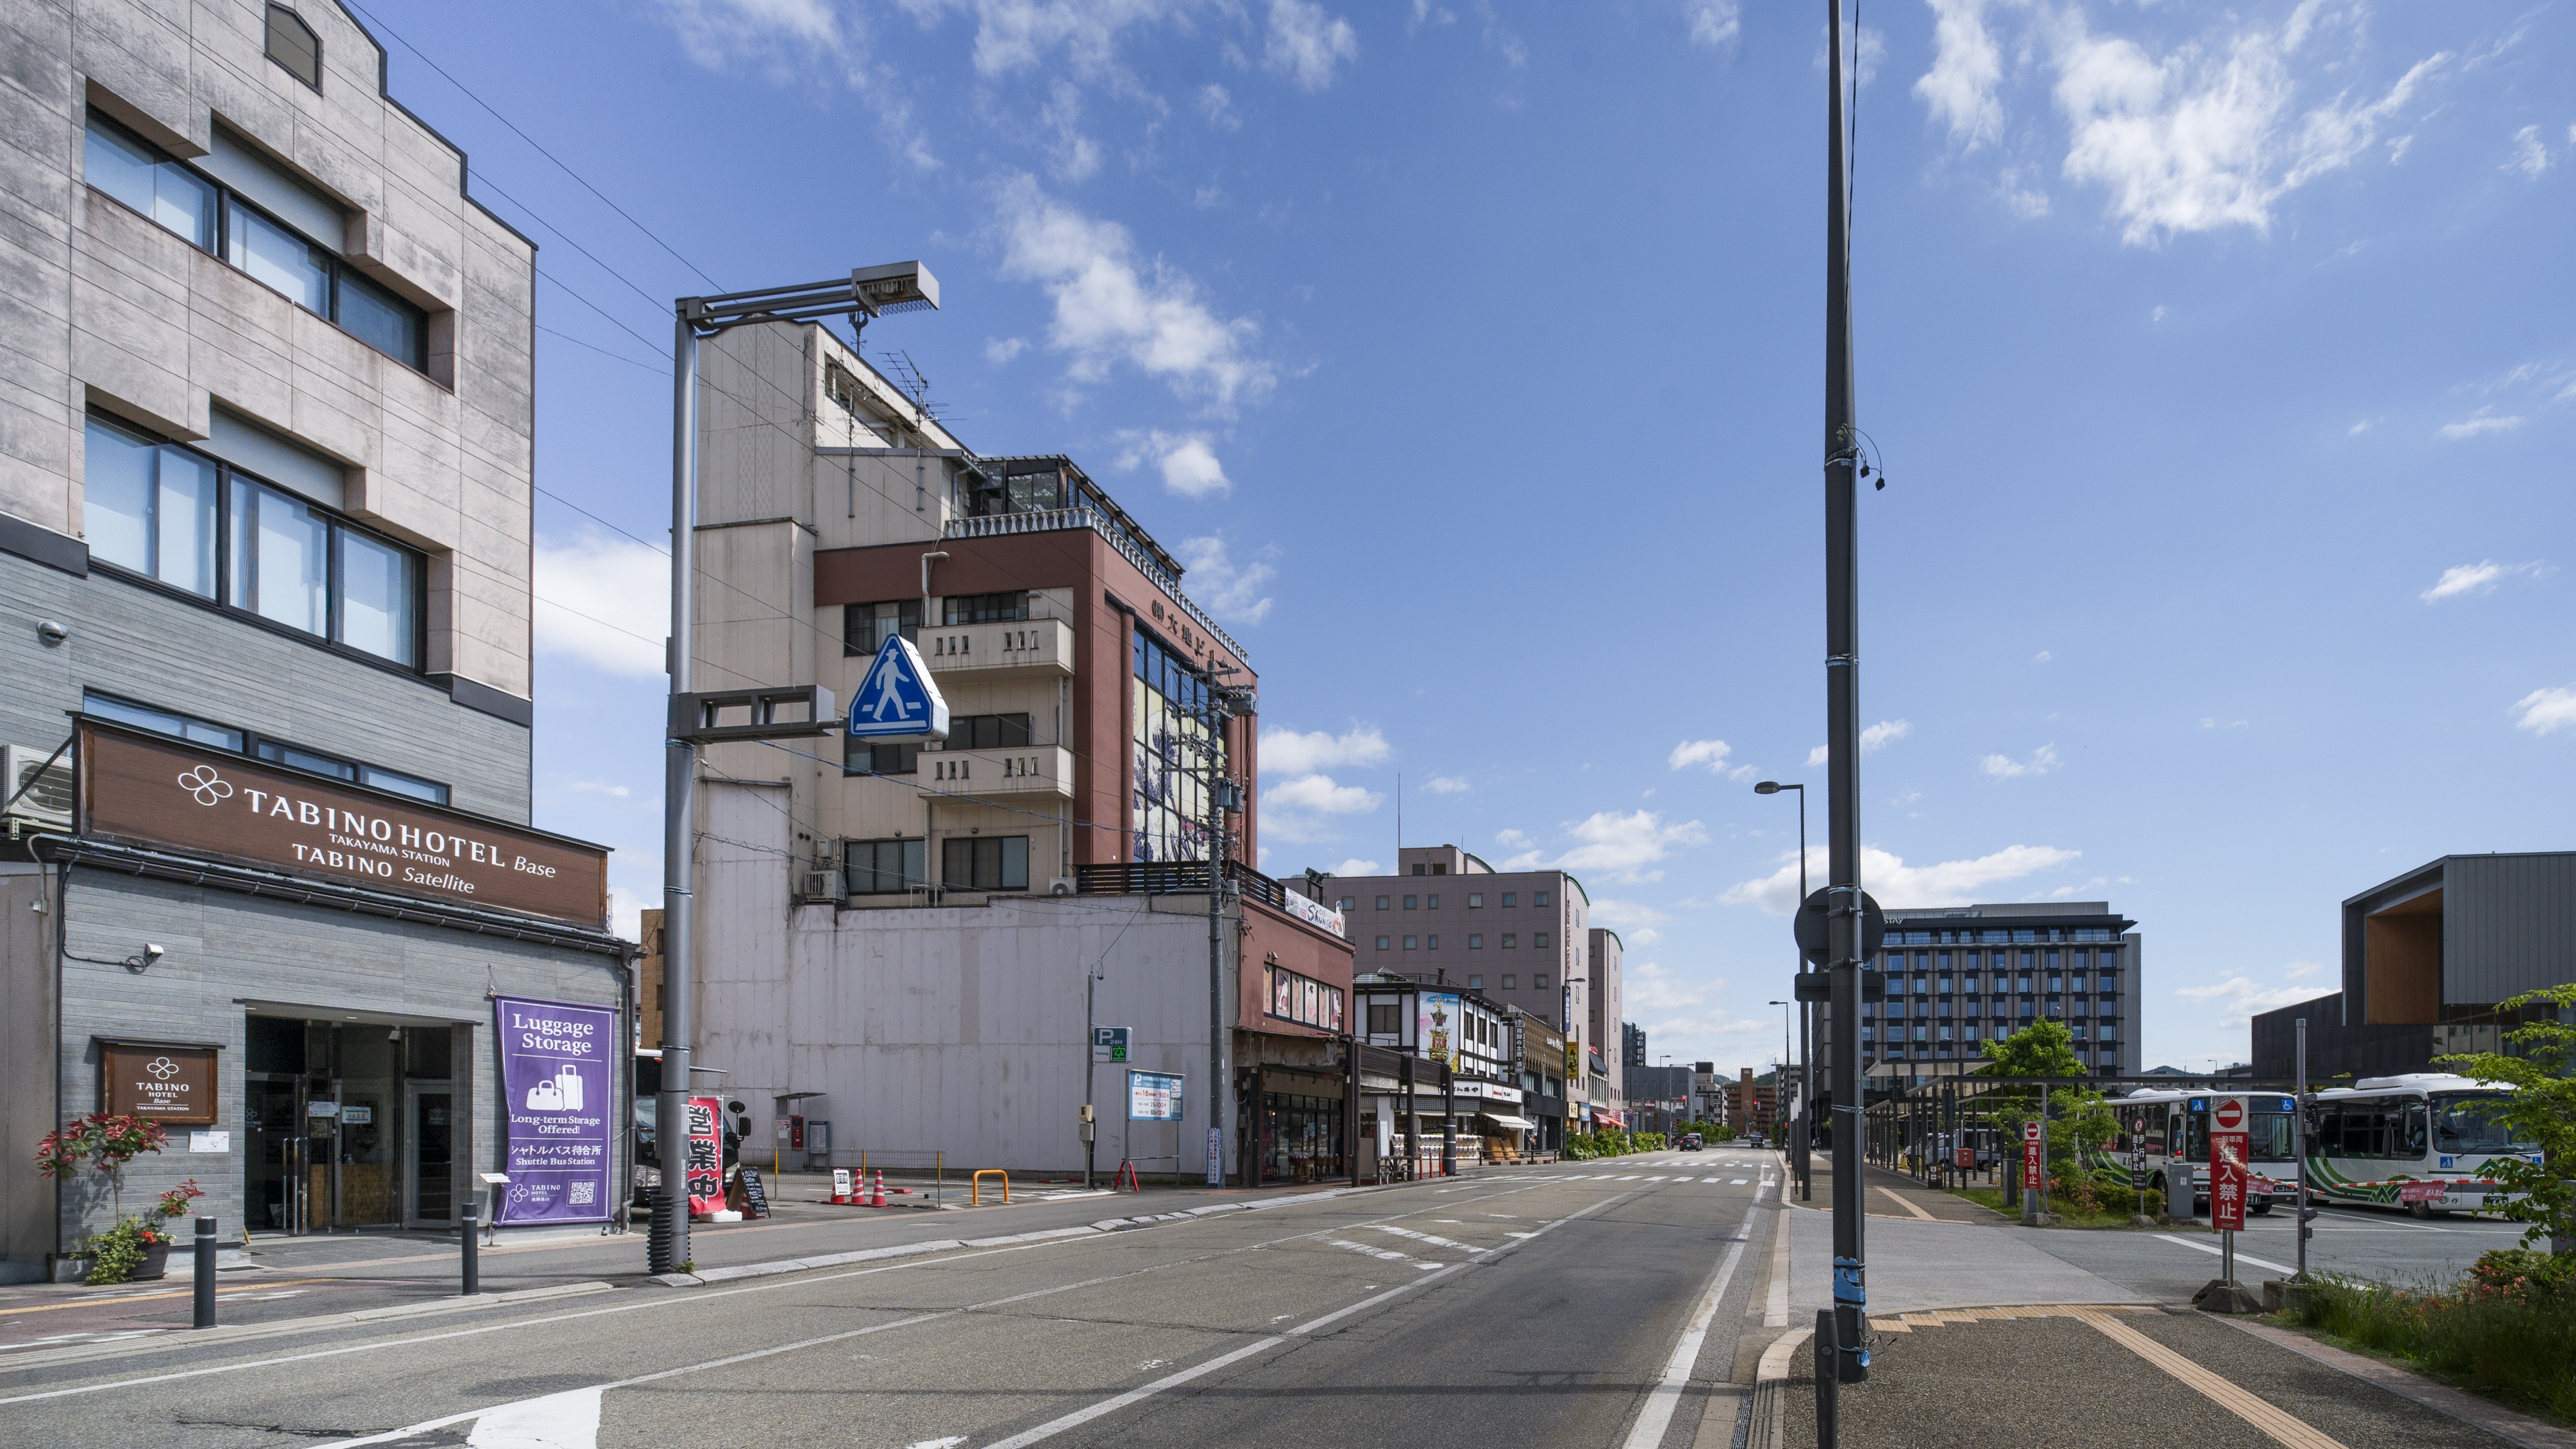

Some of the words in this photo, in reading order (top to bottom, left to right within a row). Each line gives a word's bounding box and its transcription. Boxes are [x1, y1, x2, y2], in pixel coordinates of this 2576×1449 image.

[244, 788, 392, 841] TABINO
[399, 824, 505, 868] HOTEL
[514, 856, 556, 878] Base
[329, 833, 398, 857] TAKAYAMA
[402, 849, 450, 868] STATION
[292, 843, 393, 877] TABINO
[402, 867, 475, 893] Satellite
[513, 1014, 594, 1038] Luggage
[1099, 1029, 1114, 1044] P
[522, 1033, 592, 1056] Storage
[1113, 1046, 1125, 1060] 空
[136, 1082, 189, 1092] TABINO
[511, 1114, 567, 1125] Long-term
[569, 1115, 600, 1126] Storage
[539, 1125, 580, 1134] Offered!
[511, 1145, 602, 1155] シャトルバス待合所
[2028, 1146, 2037, 1184] 進入禁止
[2219, 1145, 2239, 1220] 進入禁止
